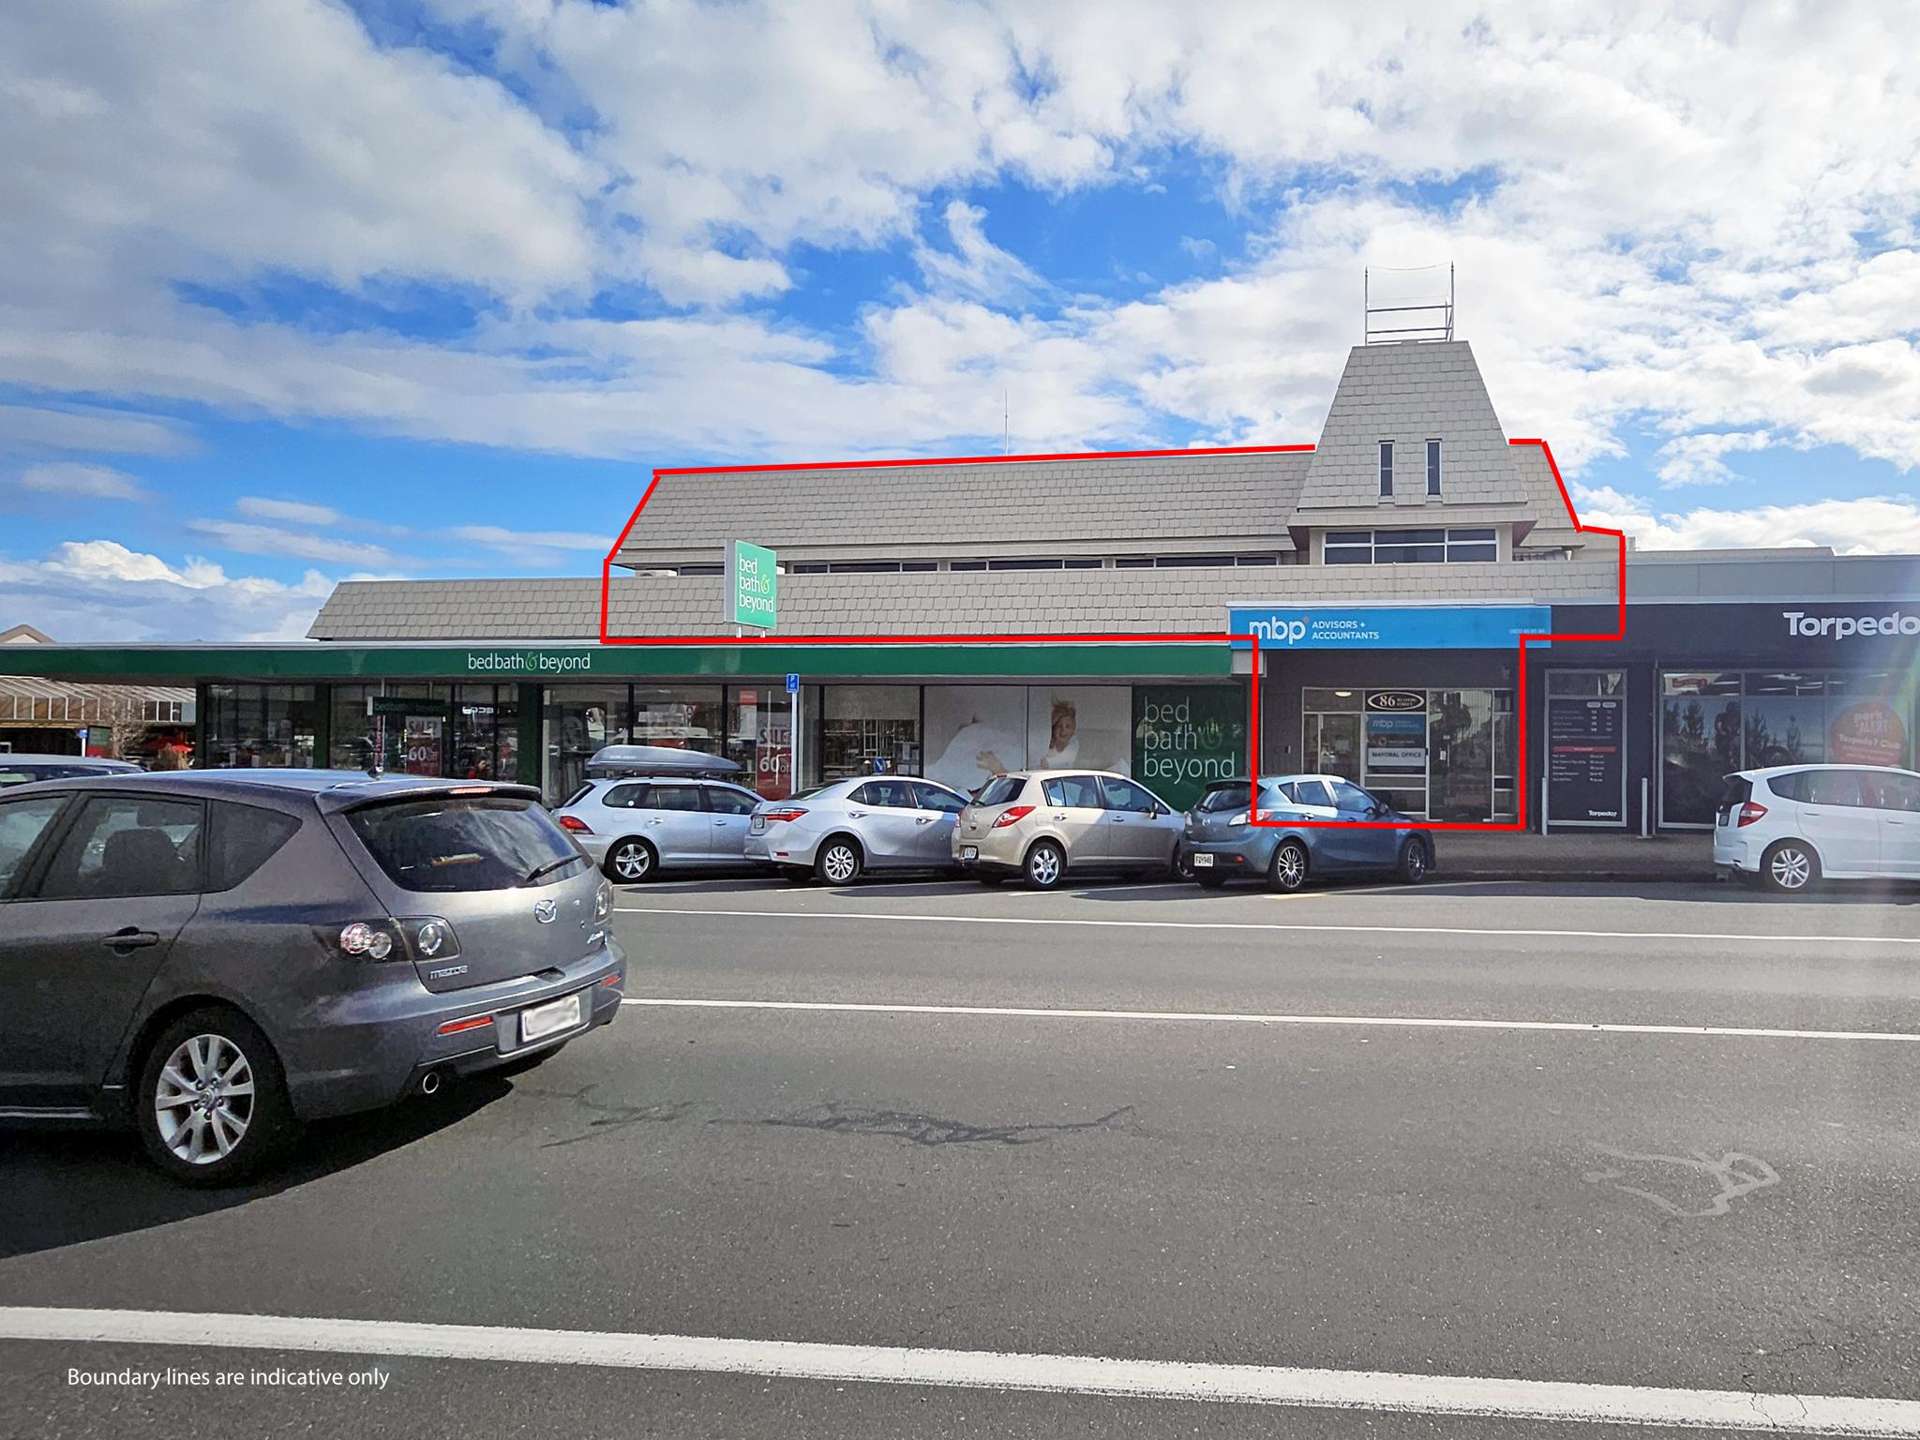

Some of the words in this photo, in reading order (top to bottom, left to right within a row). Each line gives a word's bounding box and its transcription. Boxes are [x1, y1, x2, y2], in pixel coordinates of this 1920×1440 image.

[739, 553, 758, 574] bed
[739, 572, 760, 592] bath
[739, 591, 774, 613] beyond
[1249, 616, 1306, 645] mbp
[1312, 621, 1358, 629] ADVISORS
[1312, 631, 1380, 640] ACCOUNTANTS
[468, 652, 493, 669] bed
[495, 652, 524, 669] bath
[540, 652, 591, 673] beyond
[1144, 695, 1190, 723] bed
[1379, 695, 1396, 707] 86
[1144, 723, 1197, 751] bath
[1144, 751, 1235, 784] beyond
